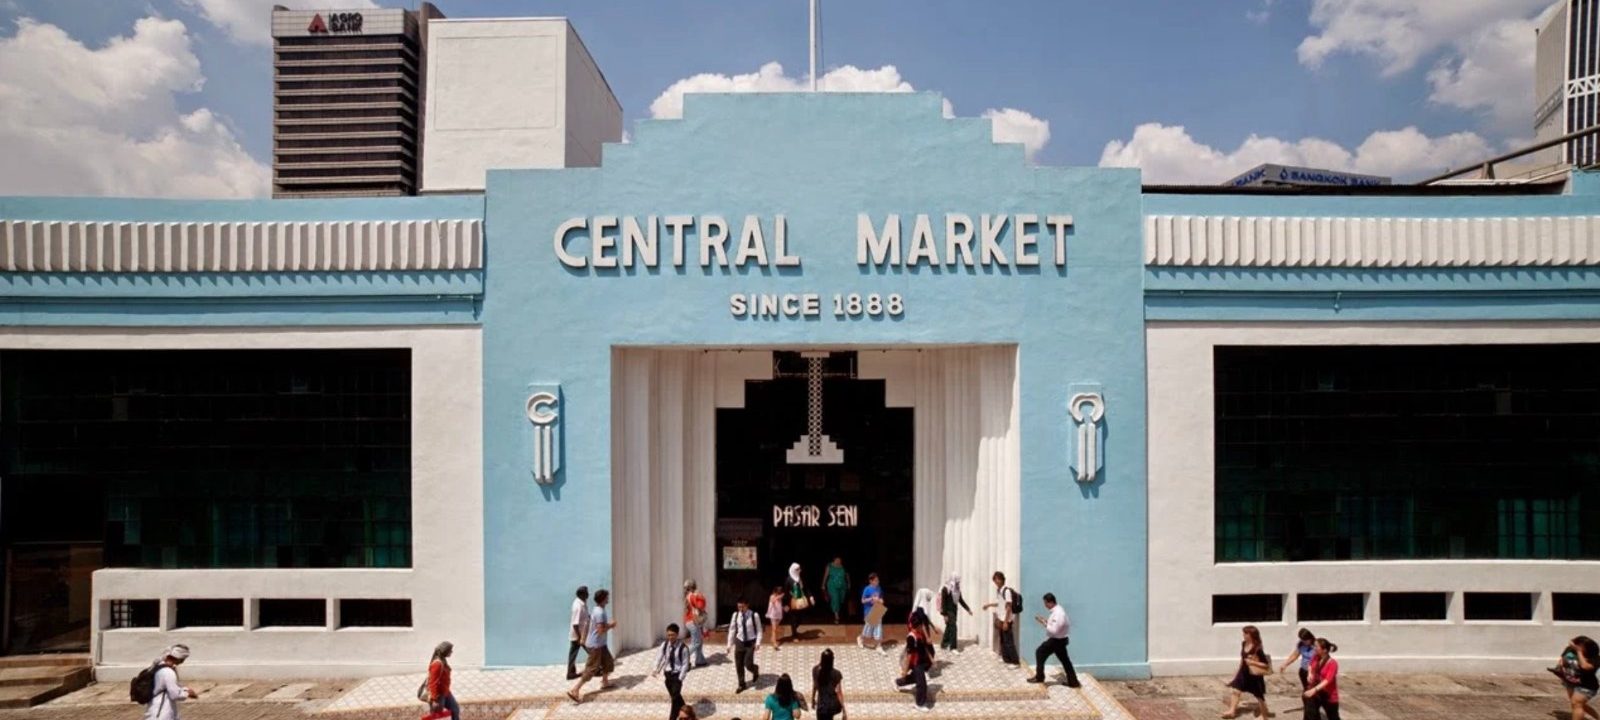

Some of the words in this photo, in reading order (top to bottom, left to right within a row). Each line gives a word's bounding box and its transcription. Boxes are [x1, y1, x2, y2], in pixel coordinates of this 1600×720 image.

[1291, 170, 1347, 185] BANGKOK
[1350, 177, 1382, 187] BANK
[553, 214, 801, 269] CENTRAL
[856, 213, 1075, 267] MARKET
[729, 293, 820, 317] SINCE
[833, 293, 904, 317] 1888
[773, 504, 821, 528] PASAR
[827, 504, 859, 528] SENI
